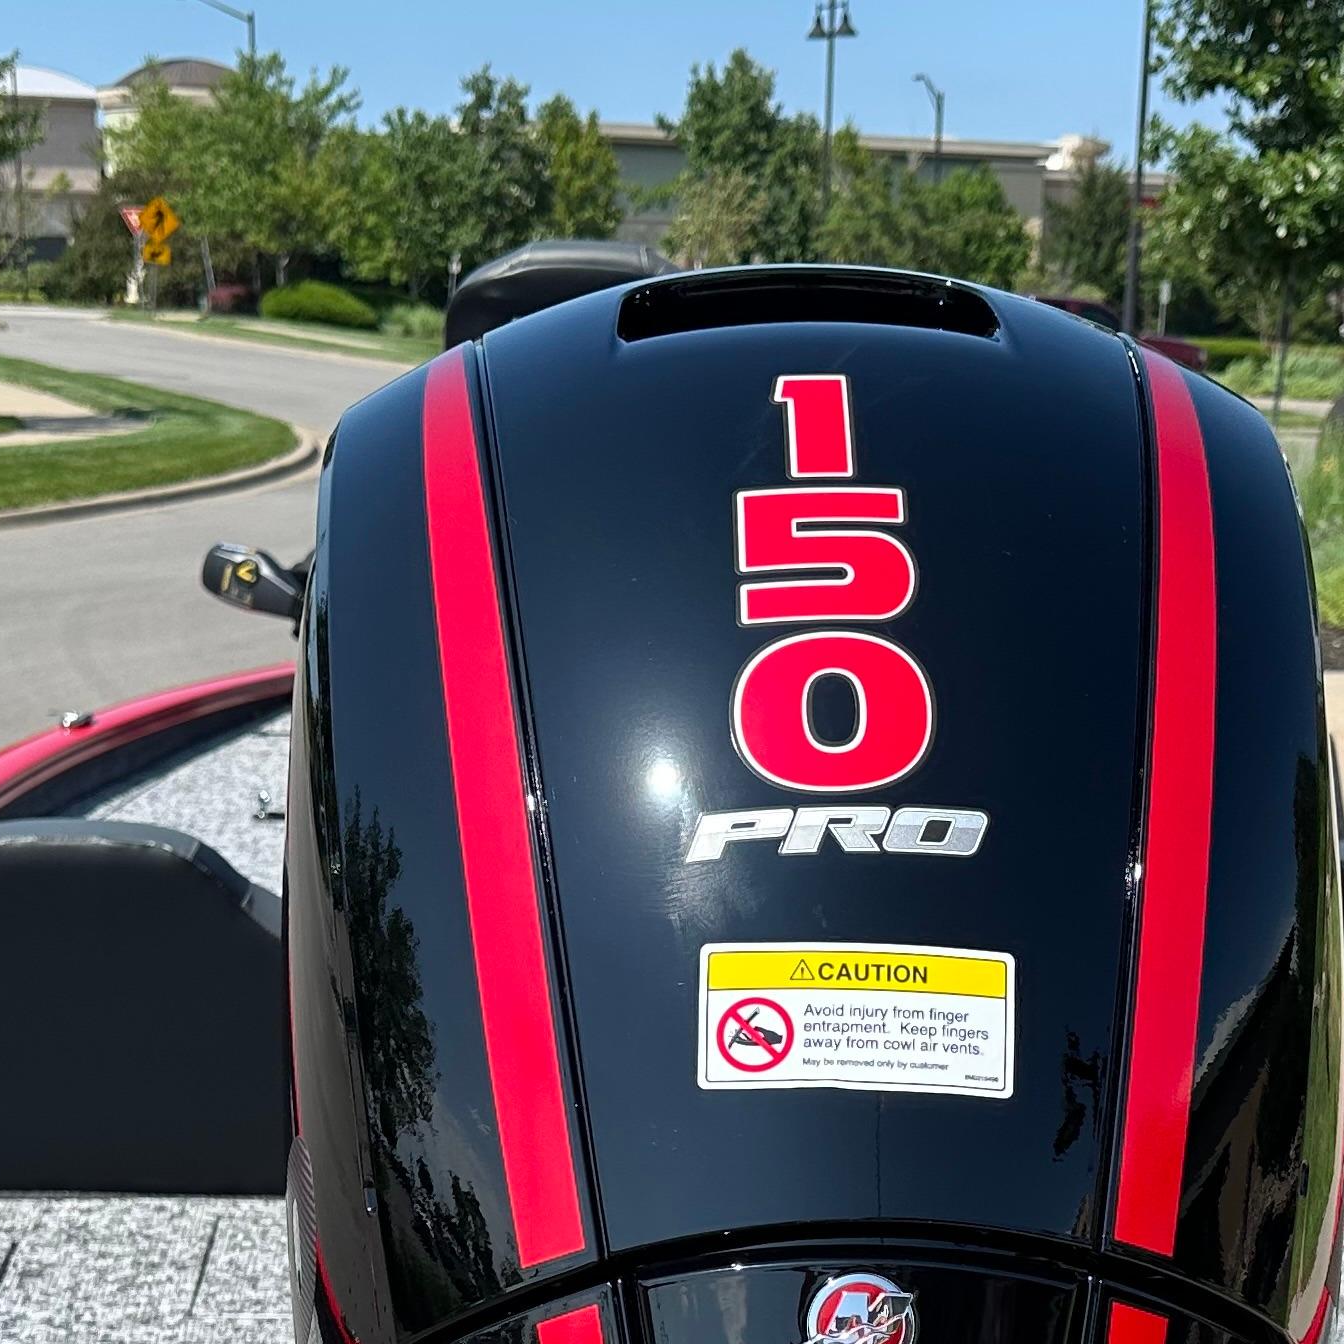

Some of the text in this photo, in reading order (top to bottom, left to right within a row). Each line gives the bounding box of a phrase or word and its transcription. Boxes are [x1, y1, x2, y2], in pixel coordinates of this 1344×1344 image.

[733, 374, 935, 793] 150
[685, 806, 991, 864] PRO
[817, 962, 929, 985] CAUTION
[803, 1003, 969, 1024] Avoid injury from finger
[900, 1022, 937, 1039] Keep
[941, 1024, 989, 1041] fingers
[803, 1038, 841, 1051] away
[845, 1036, 879, 1050] from
[883, 1038, 915, 1051] cowl
[920, 1040, 938, 1052] air
[802, 1057, 949, 1070] May be removed only by customer
